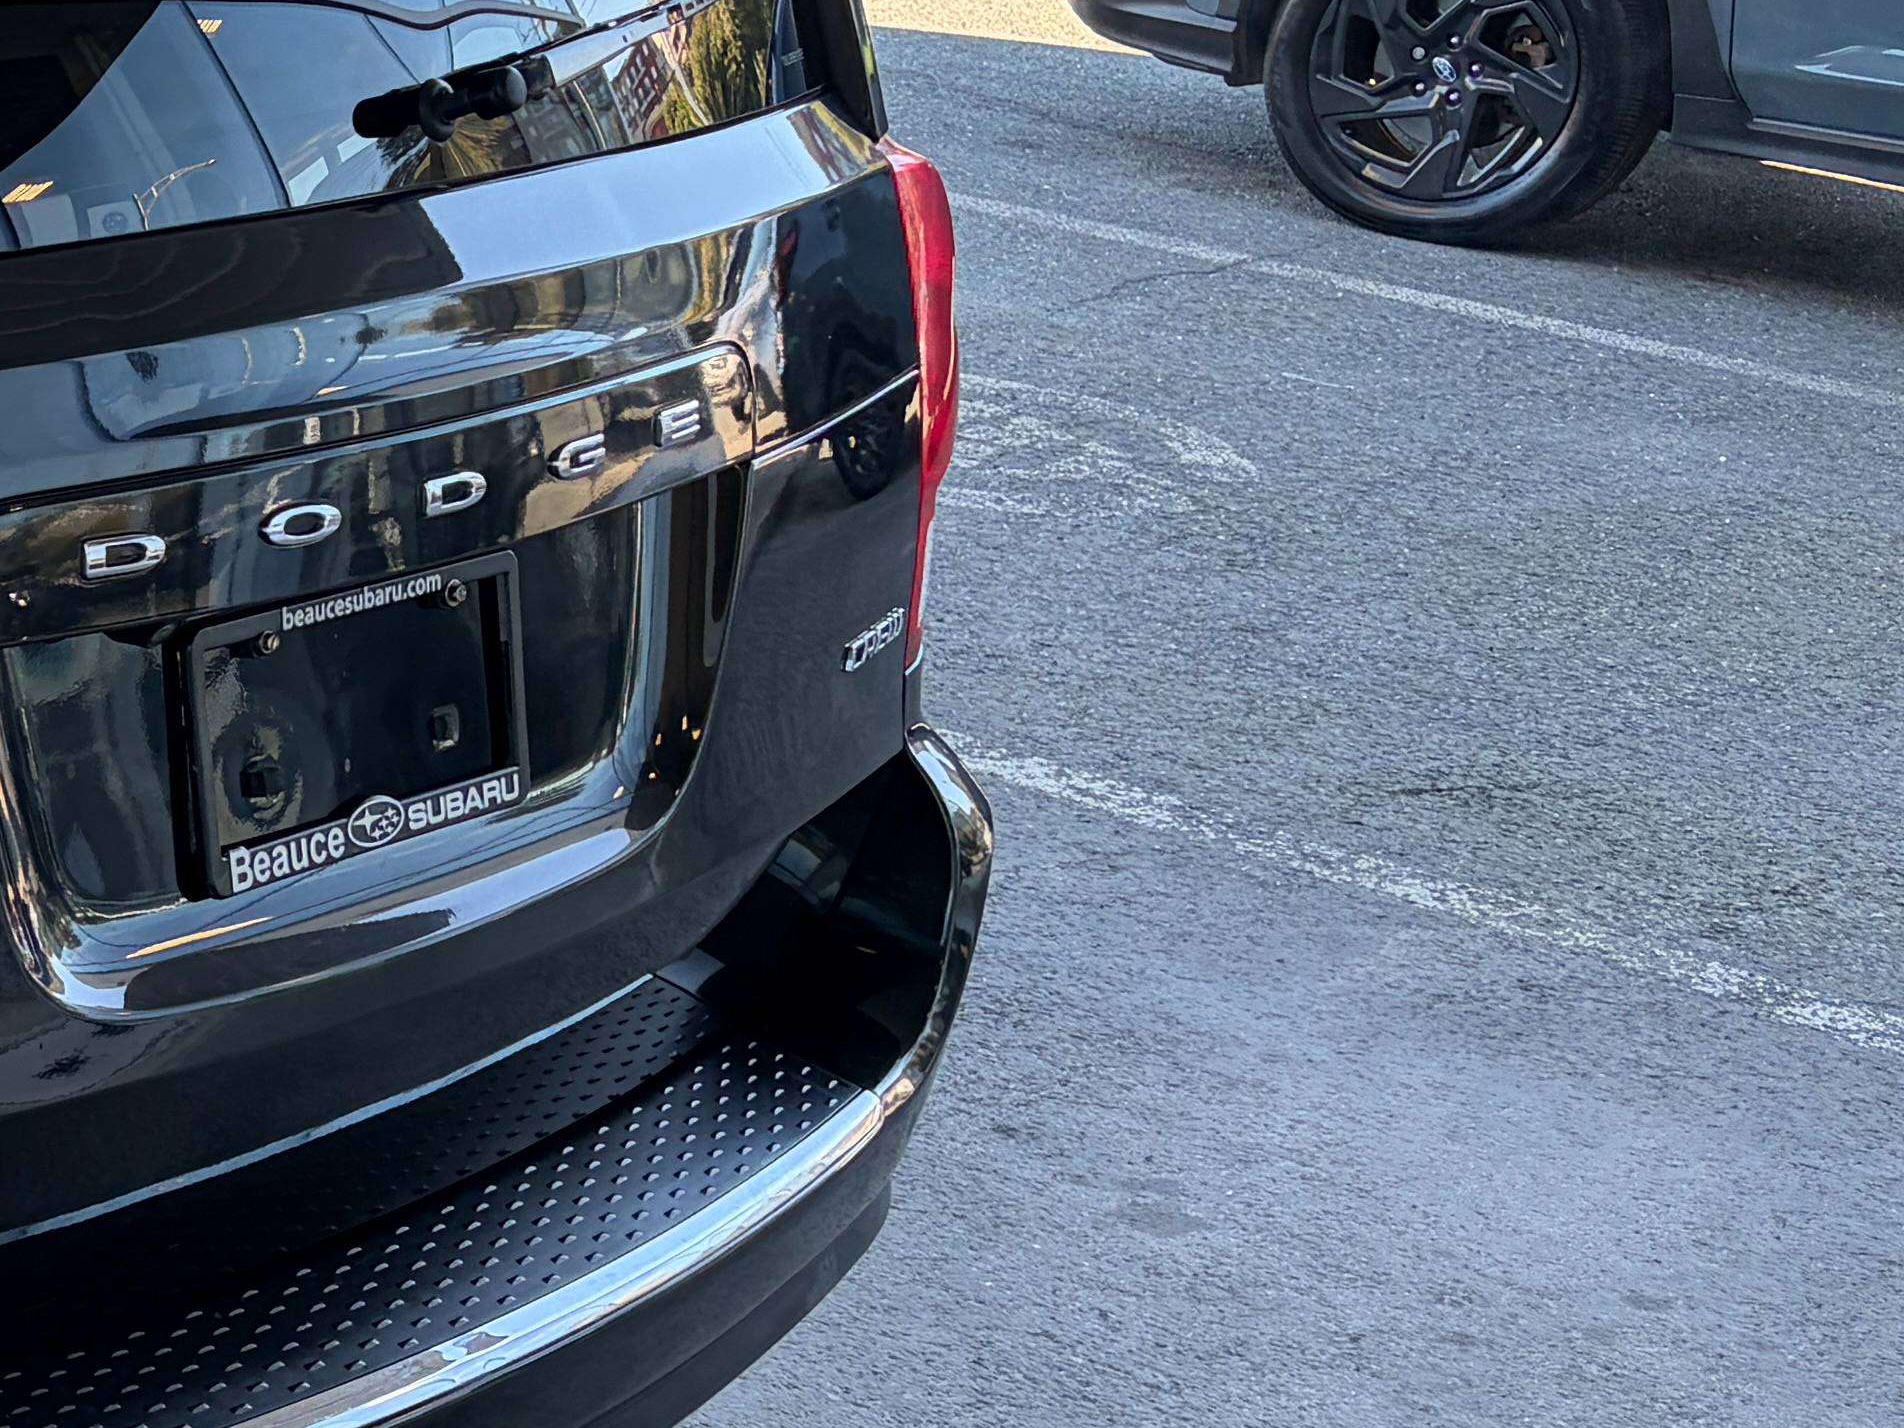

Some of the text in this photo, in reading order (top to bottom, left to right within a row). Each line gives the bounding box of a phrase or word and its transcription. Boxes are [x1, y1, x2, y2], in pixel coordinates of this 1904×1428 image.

[80, 398, 702, 580] DODGE
[281, 573, 442, 631] beaucesubaru.com
[229, 773, 520, 893] Beauce SUBARU
